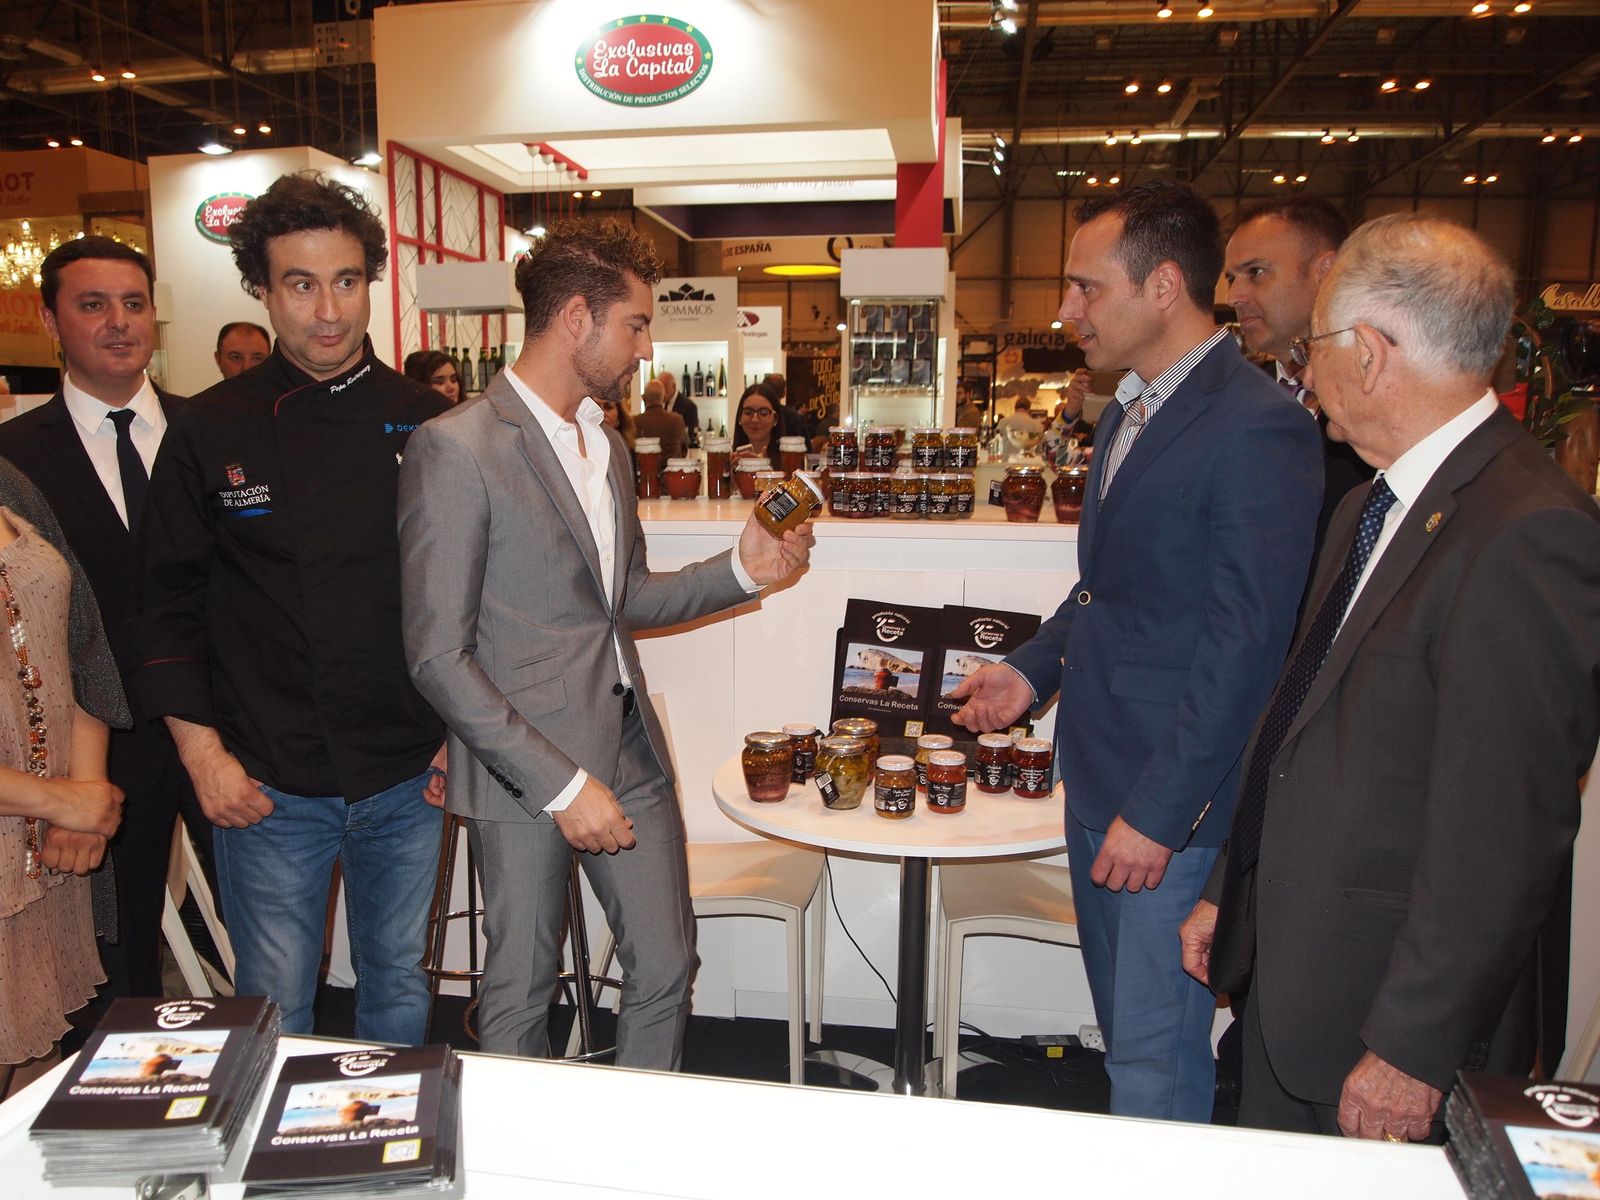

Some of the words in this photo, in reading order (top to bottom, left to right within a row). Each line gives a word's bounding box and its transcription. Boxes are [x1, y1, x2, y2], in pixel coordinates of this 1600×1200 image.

[593, 38, 694, 61] Exclusivas
[593, 57, 620, 79] La
[626, 55, 694, 81] Capital
[578, 67, 623, 102] DISTRIBUCIÓN
[622, 94, 634, 103] DE
[634, 89, 679, 104] PRODUCTOS
[678, 63, 709, 95] SELECTOS
[205, 215, 220, 228] La
[734, 240, 772, 256] ESPAÑA
[660, 304, 713, 316] SOMMOS
[219, 484, 270, 498] DIPUTACIÓN
[224, 499, 233, 507] DE
[234, 493, 271, 507] ALMERÍA
[871, 611, 894, 620] producto
[894, 612, 911, 625] natural
[969, 617, 992, 626] producto
[992, 618, 1010, 630] natural
[881, 628, 904, 636] Receta
[980, 634, 1003, 642] Receta
[839, 695, 879, 706] Conservas
[891, 701, 919, 711] Receta
[68, 1084, 141, 1095] Conservas
[142, 1084, 161, 1094] La
[162, 1082, 210, 1094] Receta
[271, 1132, 347, 1146] Conservas
[350, 1130, 368, 1140] La
[369, 1125, 420, 1138] Receta
